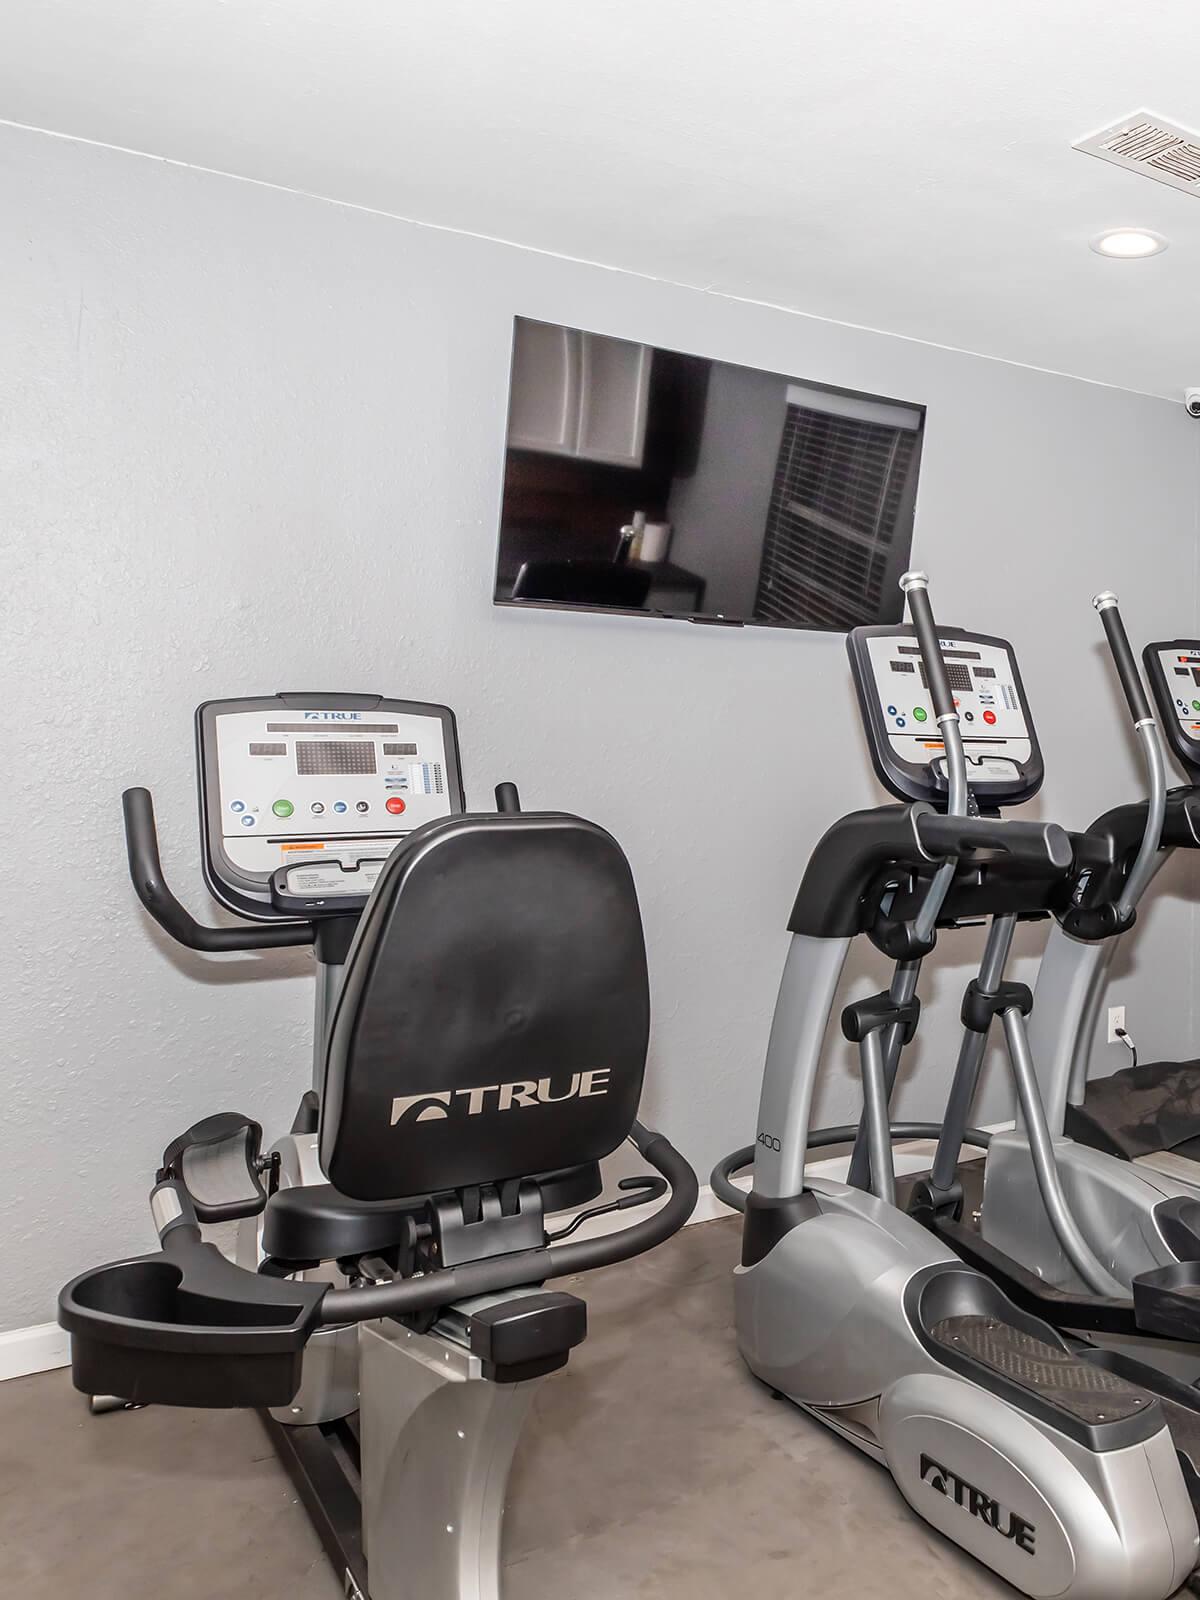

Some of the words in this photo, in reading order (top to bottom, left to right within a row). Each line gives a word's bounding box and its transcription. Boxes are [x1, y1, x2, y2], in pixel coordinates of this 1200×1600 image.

[320, 712, 361, 720] TRUE
[455, 1068, 611, 1115] TRUE
[757, 1132, 781, 1152] 400
[947, 1469, 1036, 1556] TRUE
